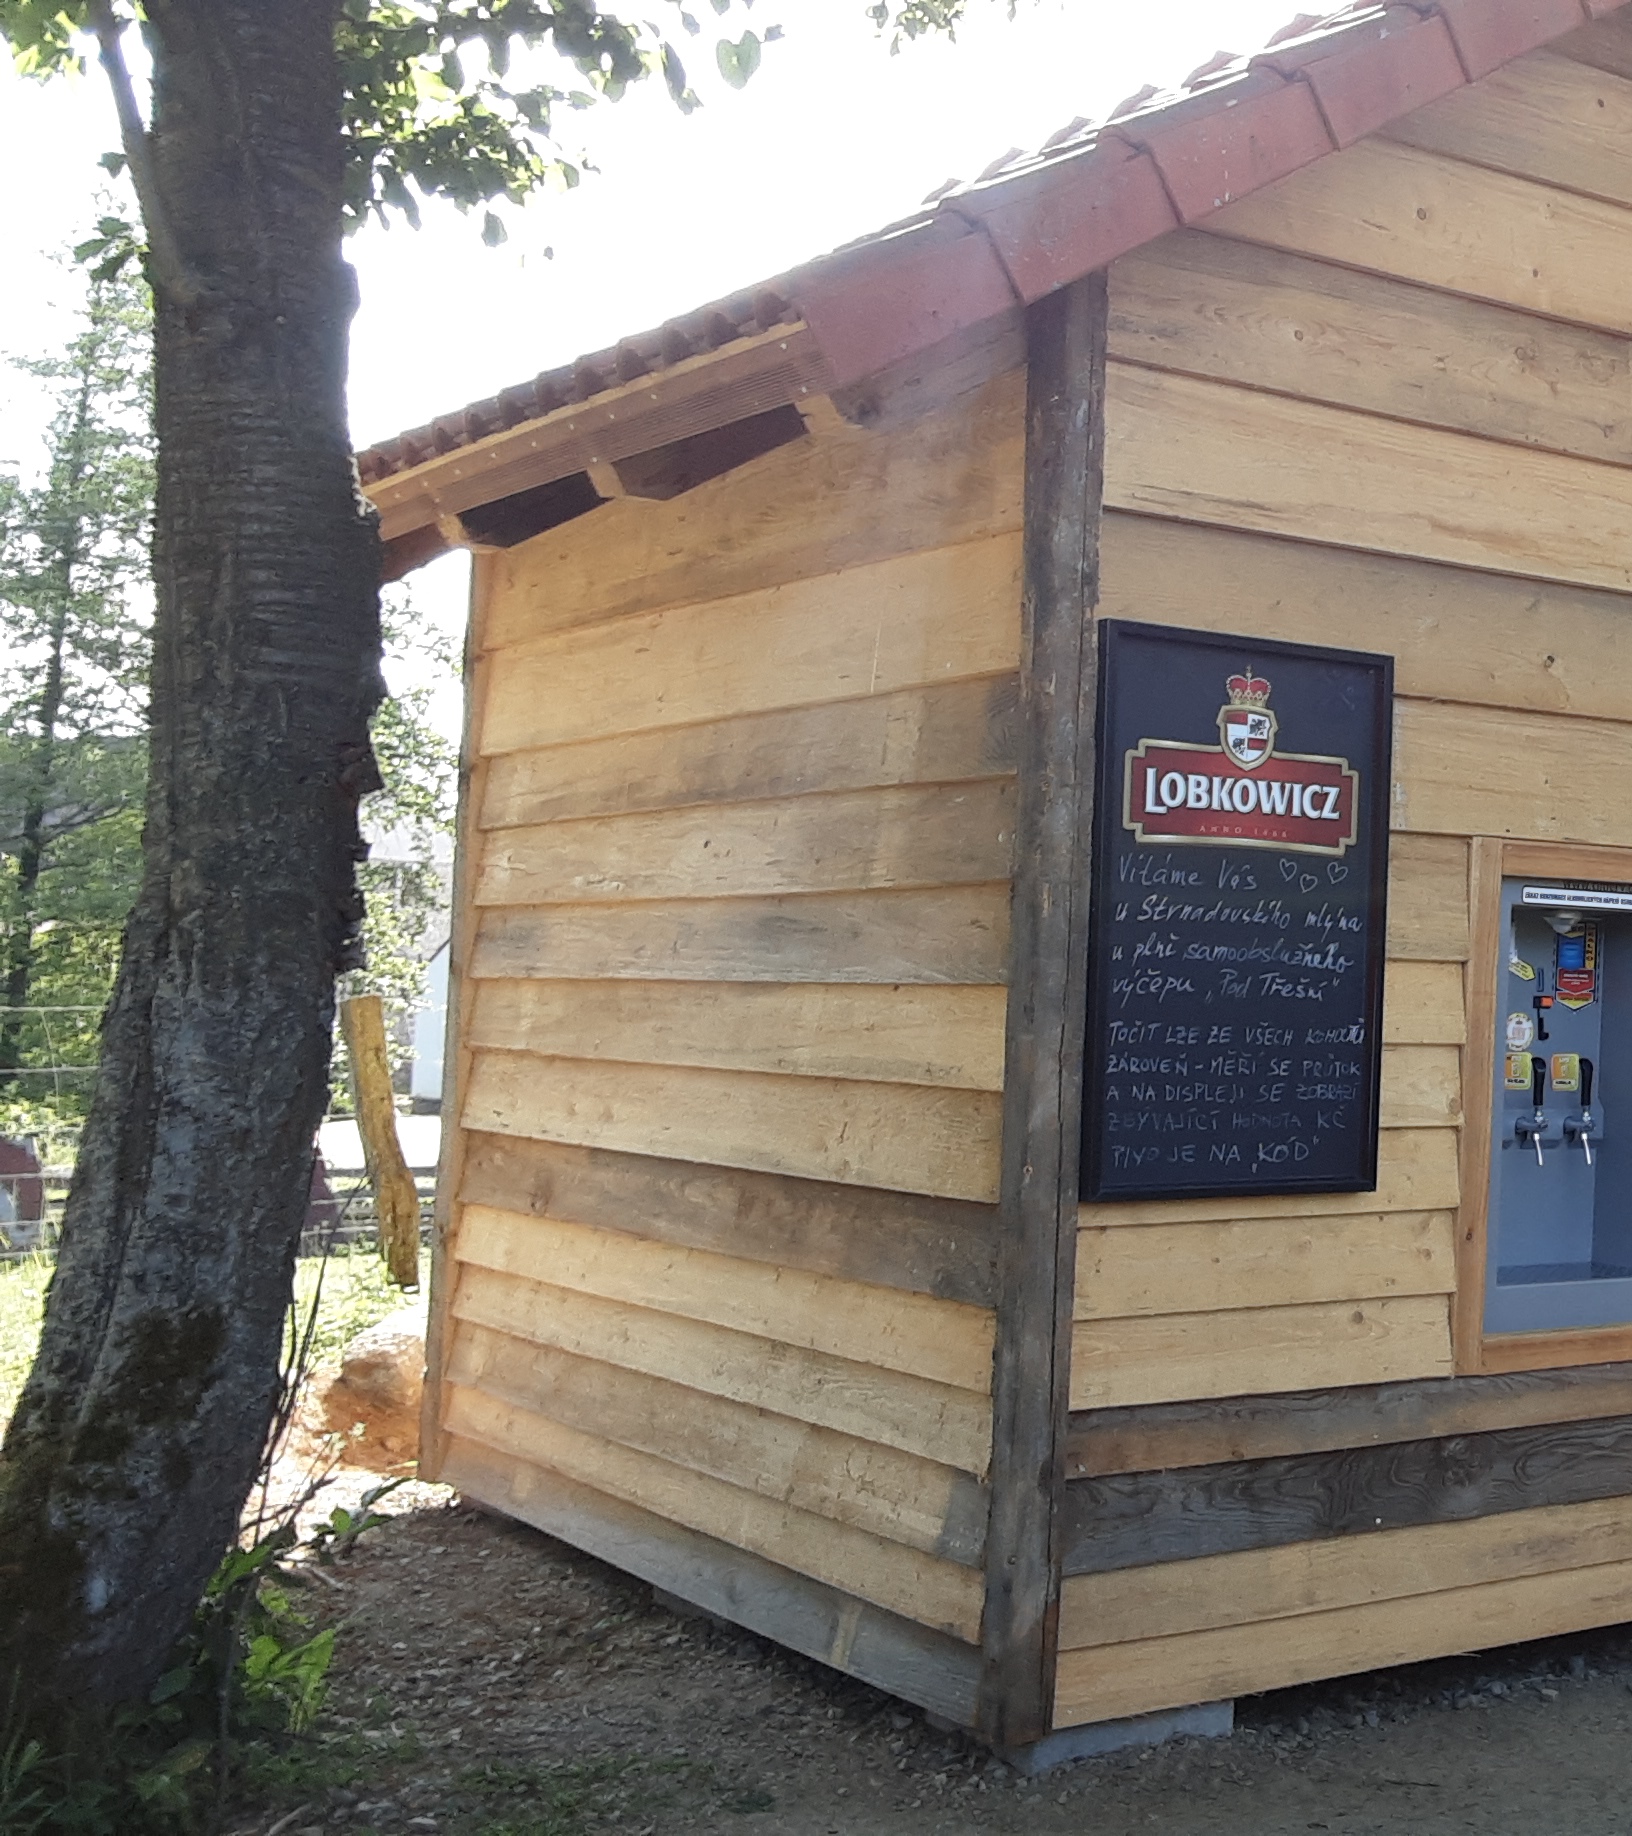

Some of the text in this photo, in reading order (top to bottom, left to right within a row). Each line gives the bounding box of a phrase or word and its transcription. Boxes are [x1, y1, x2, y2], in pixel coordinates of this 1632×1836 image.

[1144, 767, 1341, 820] LOBKOWICZ
[1115, 902, 1128, 921] u
[1303, 902, 1363, 943] mlýna
[1112, 946, 1124, 960] u
[1112, 968, 1195, 1008] výčepu
[1109, 1020, 1162, 1046] TOČIT
[1165, 1026, 1199, 1045] LZE
[1207, 1026, 1232, 1045] ZE
[1245, 1021, 1293, 1046] VŠECH
[1105, 1051, 1188, 1076] ZÁROVEŇ
[1268, 1058, 1292, 1076] SE
[1106, 1086, 1119, 1100] A
[1131, 1083, 1156, 1101] NA
[1165, 1083, 1244, 1104] DISPLEJI
[1258, 1083, 1285, 1101] SE
[1317, 1106, 1346, 1129] KČ
[1112, 1145, 1159, 1168] PIVO
[1168, 1145, 1196, 1162] JE
[1209, 1143, 1241, 1165] NA
